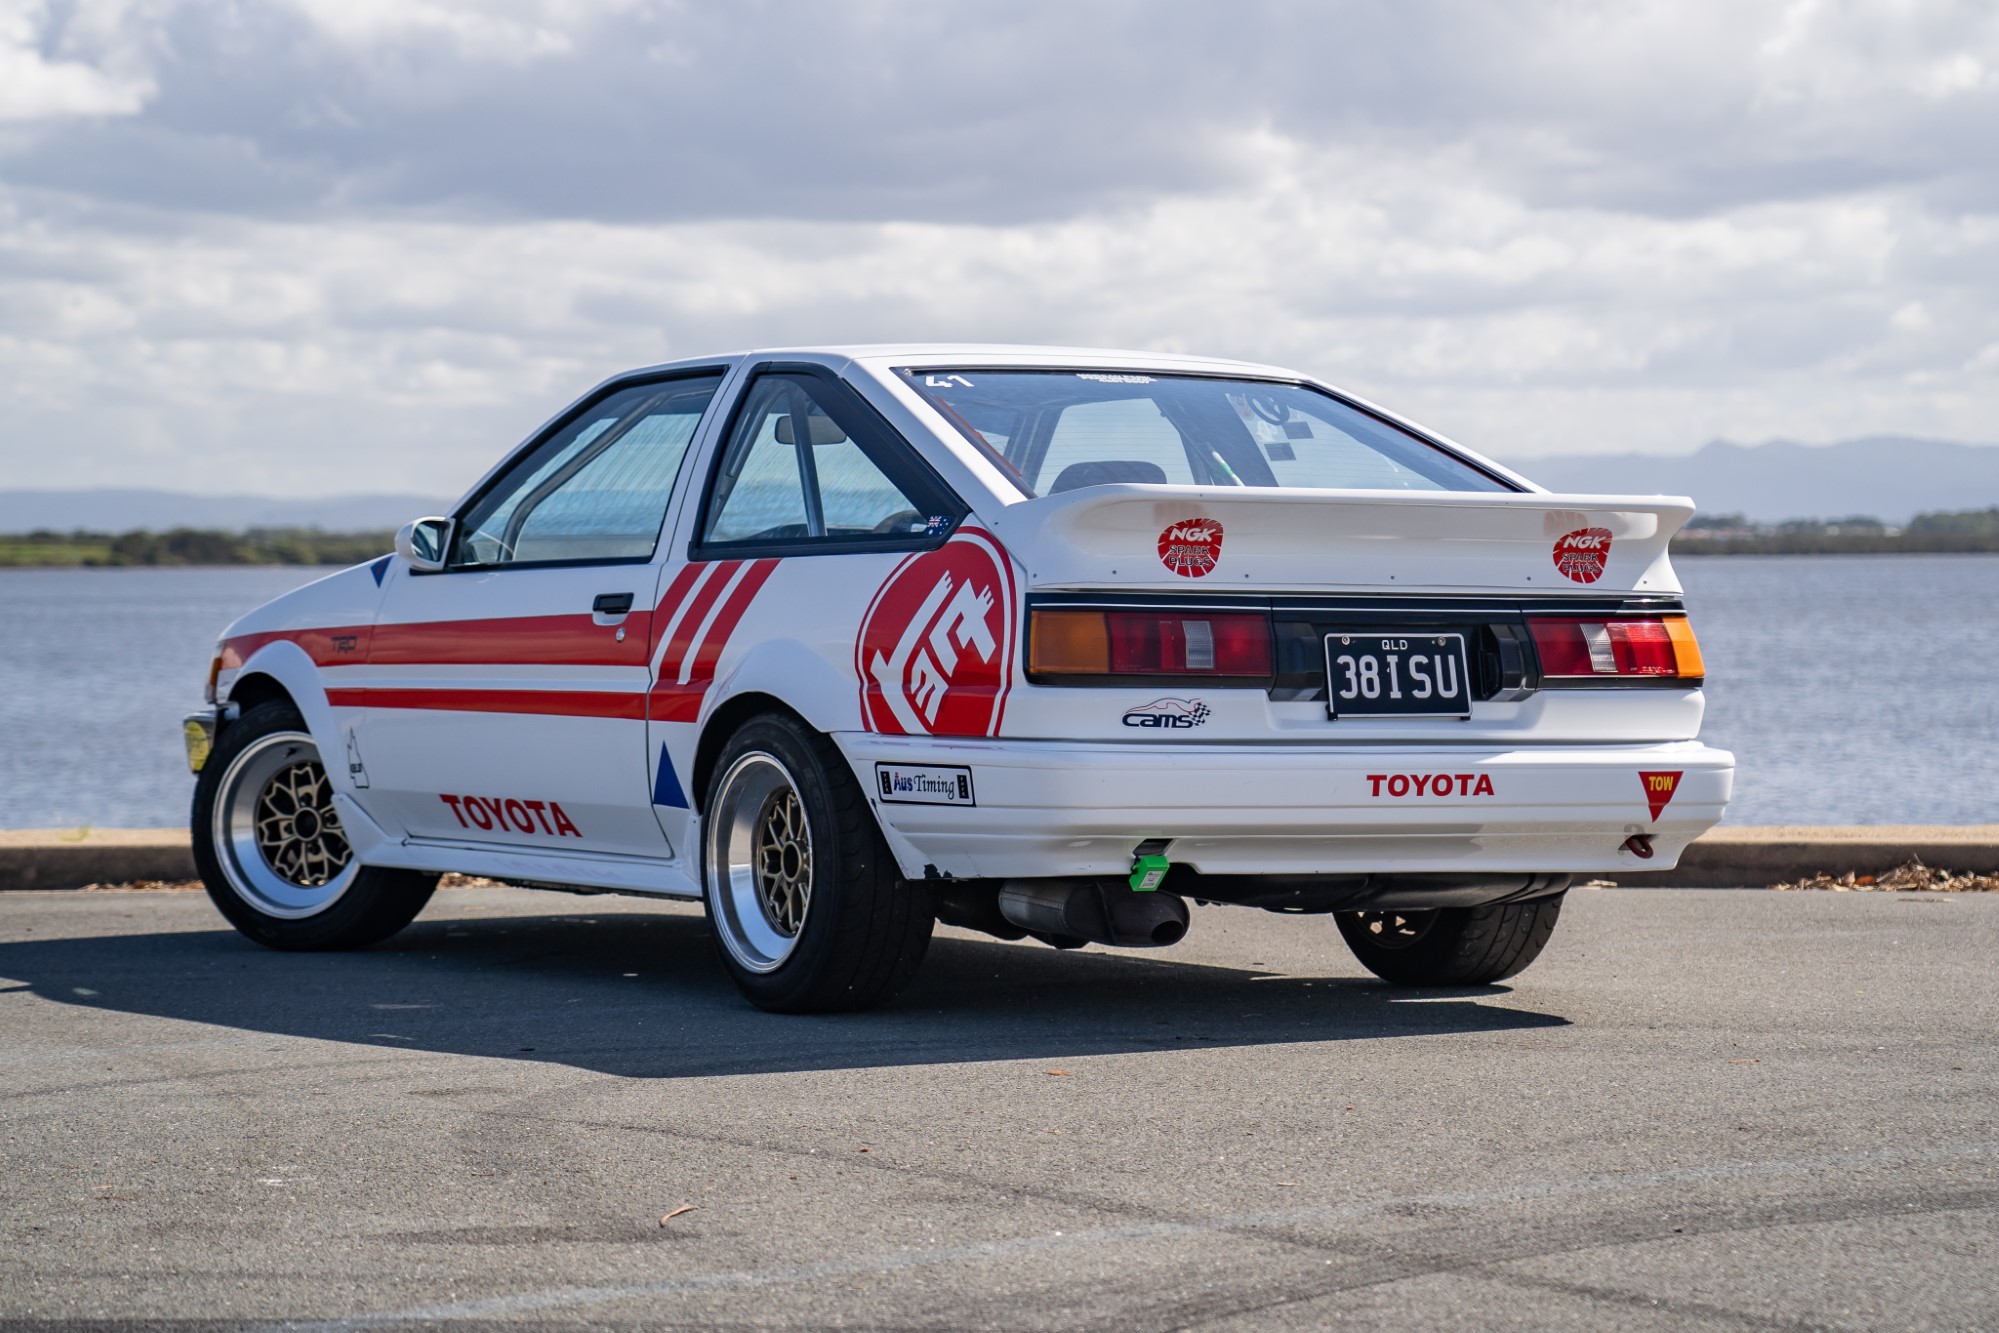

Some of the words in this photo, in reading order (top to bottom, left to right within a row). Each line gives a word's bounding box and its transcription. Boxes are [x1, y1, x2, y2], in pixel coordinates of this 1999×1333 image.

[925, 375, 975, 388] 41
[1169, 527, 1217, 542] NGK
[1562, 535, 1607, 549] NGK
[1169, 545, 1211, 555] SPARK
[1168, 556, 1212, 567] PLUGS
[1562, 552, 1600, 562] SPARK
[1562, 563, 1601, 574] PLUGS
[1381, 639, 1408, 650] QLD
[1121, 713, 1194, 729] cams
[1366, 773, 1495, 797] TOYOTA
[1648, 776, 1674, 791] TOW
[438, 793, 584, 838] TOYOTA
